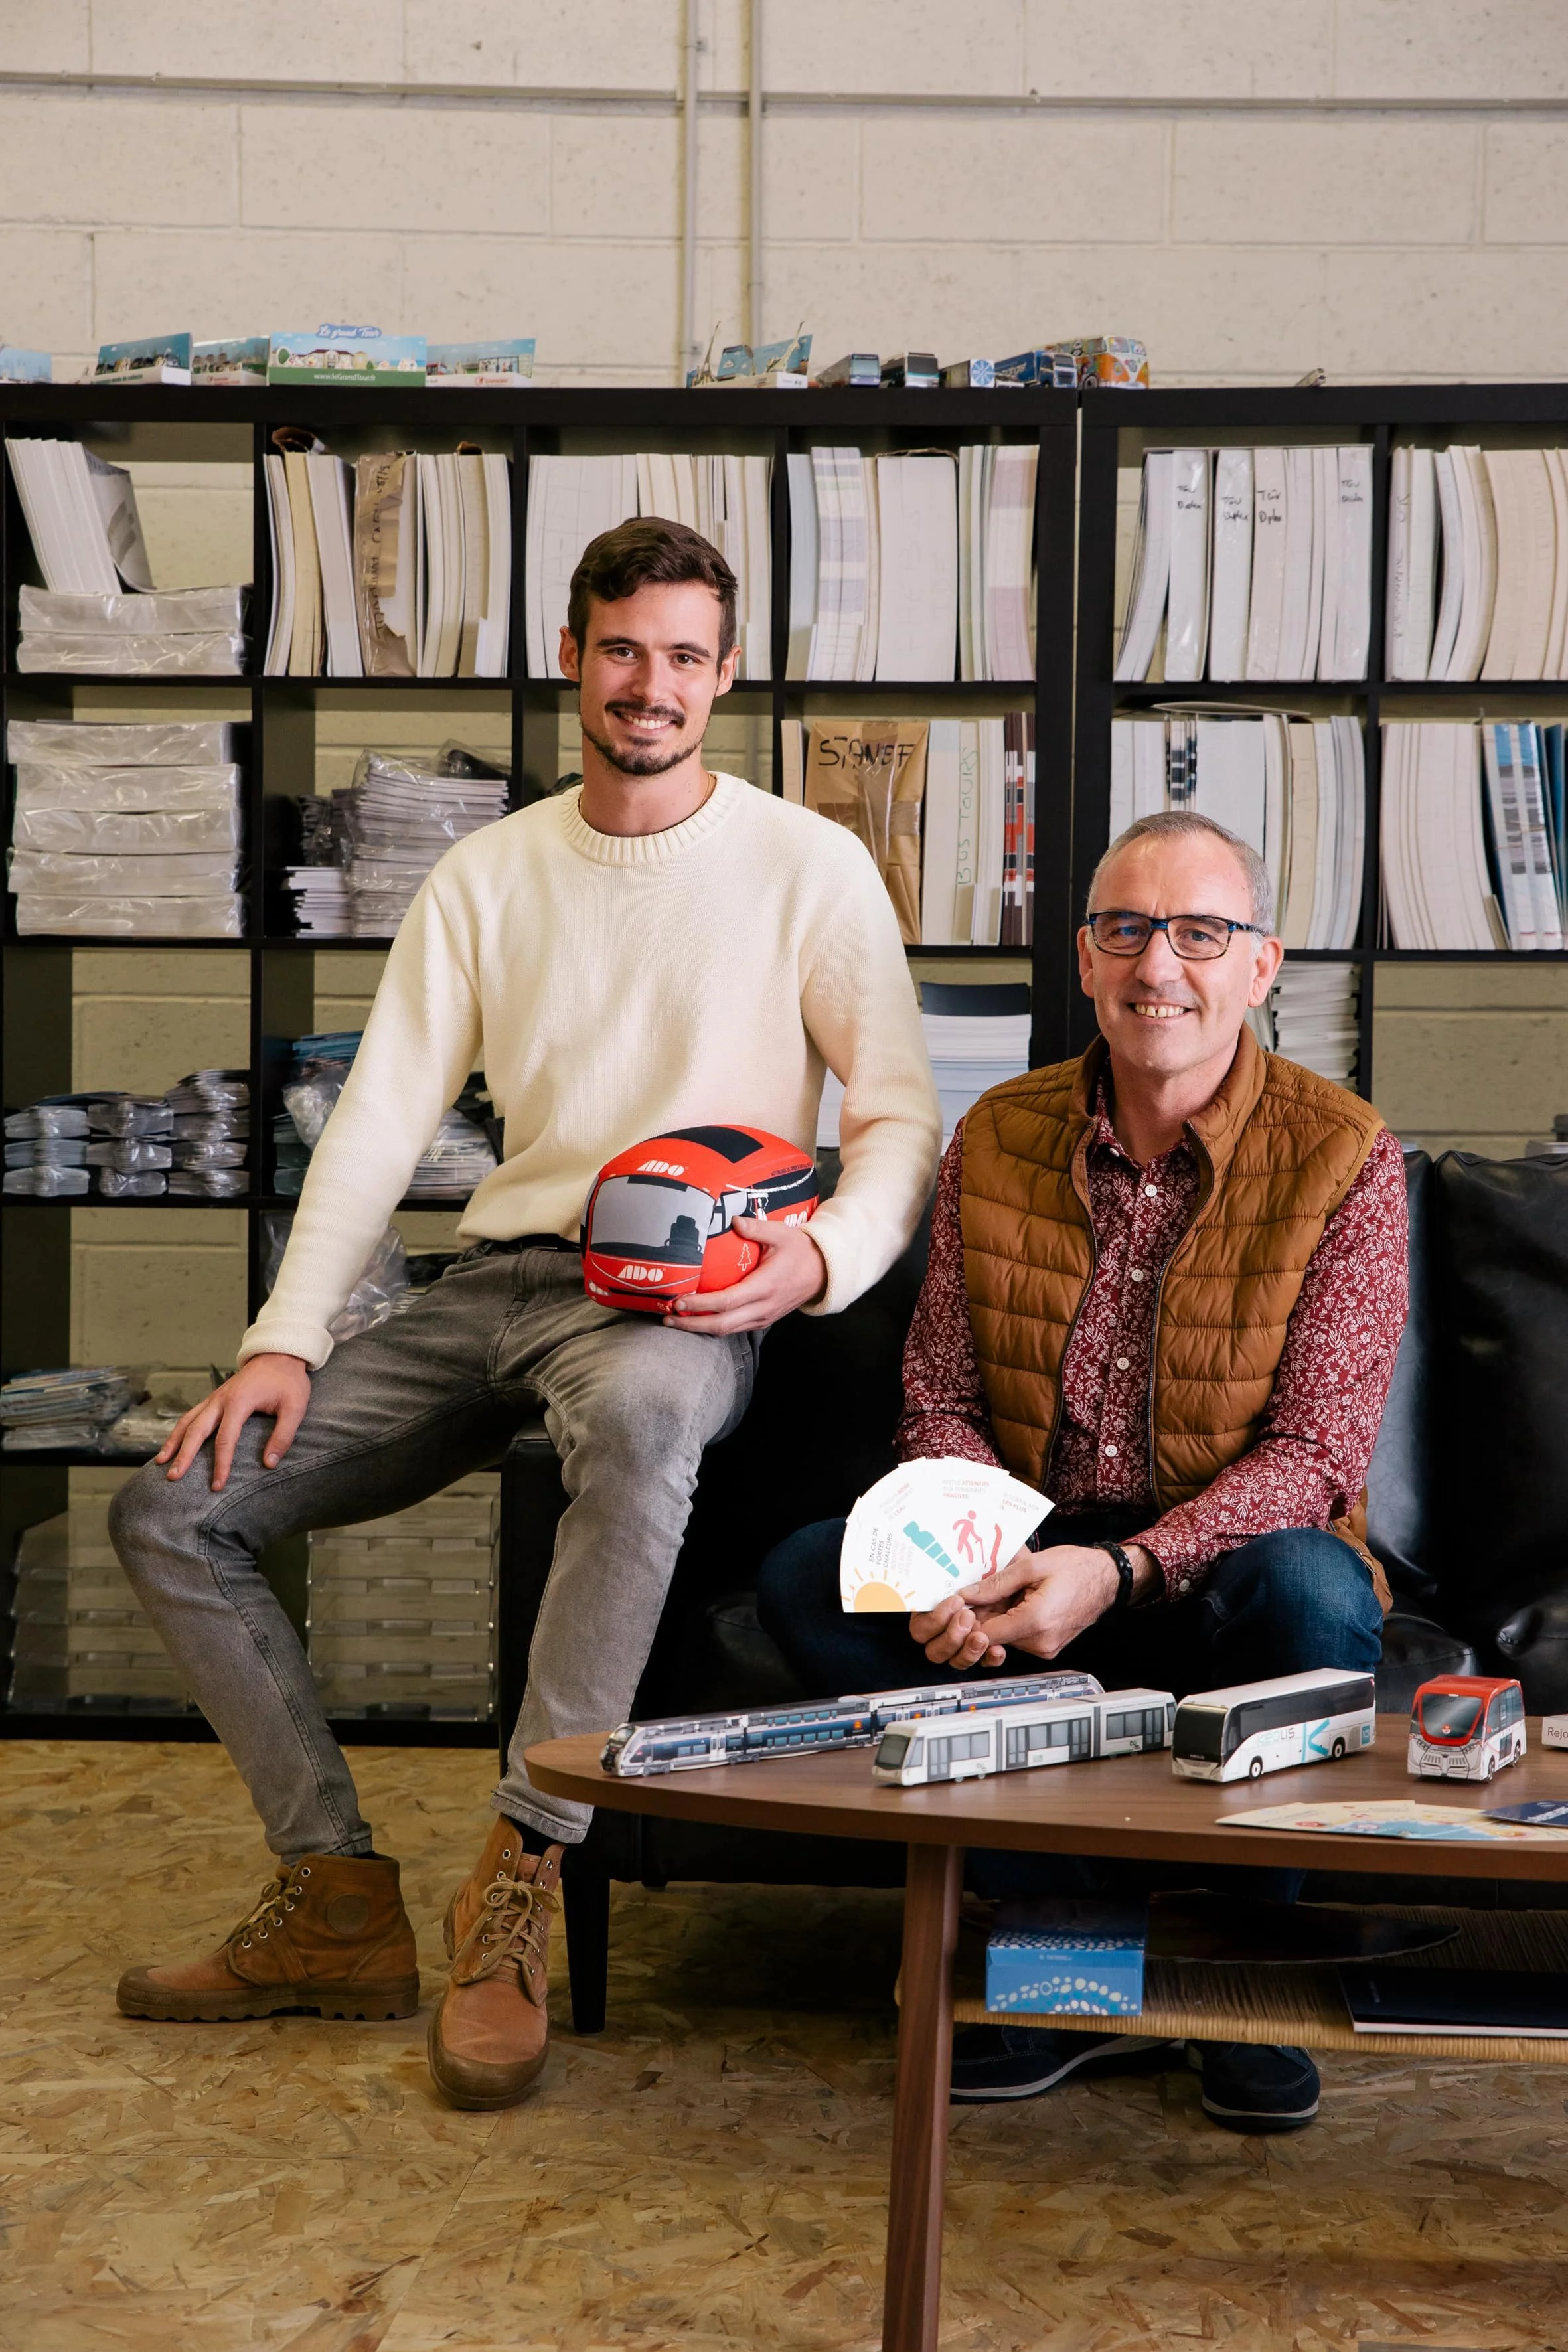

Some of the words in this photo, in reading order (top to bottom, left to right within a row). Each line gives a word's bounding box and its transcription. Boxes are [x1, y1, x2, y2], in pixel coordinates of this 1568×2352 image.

[958, 746, 979, 826] TOURS
[955, 838, 972, 884] BUS
[636, 1160, 685, 1176] ADO
[617, 1265, 664, 1282] ADO
[868, 1551, 875, 1562] EN
[872, 1527, 879, 1536] DE
[876, 1539, 884, 1565] FORTES
[883, 1533, 893, 1568] CHALEURS
